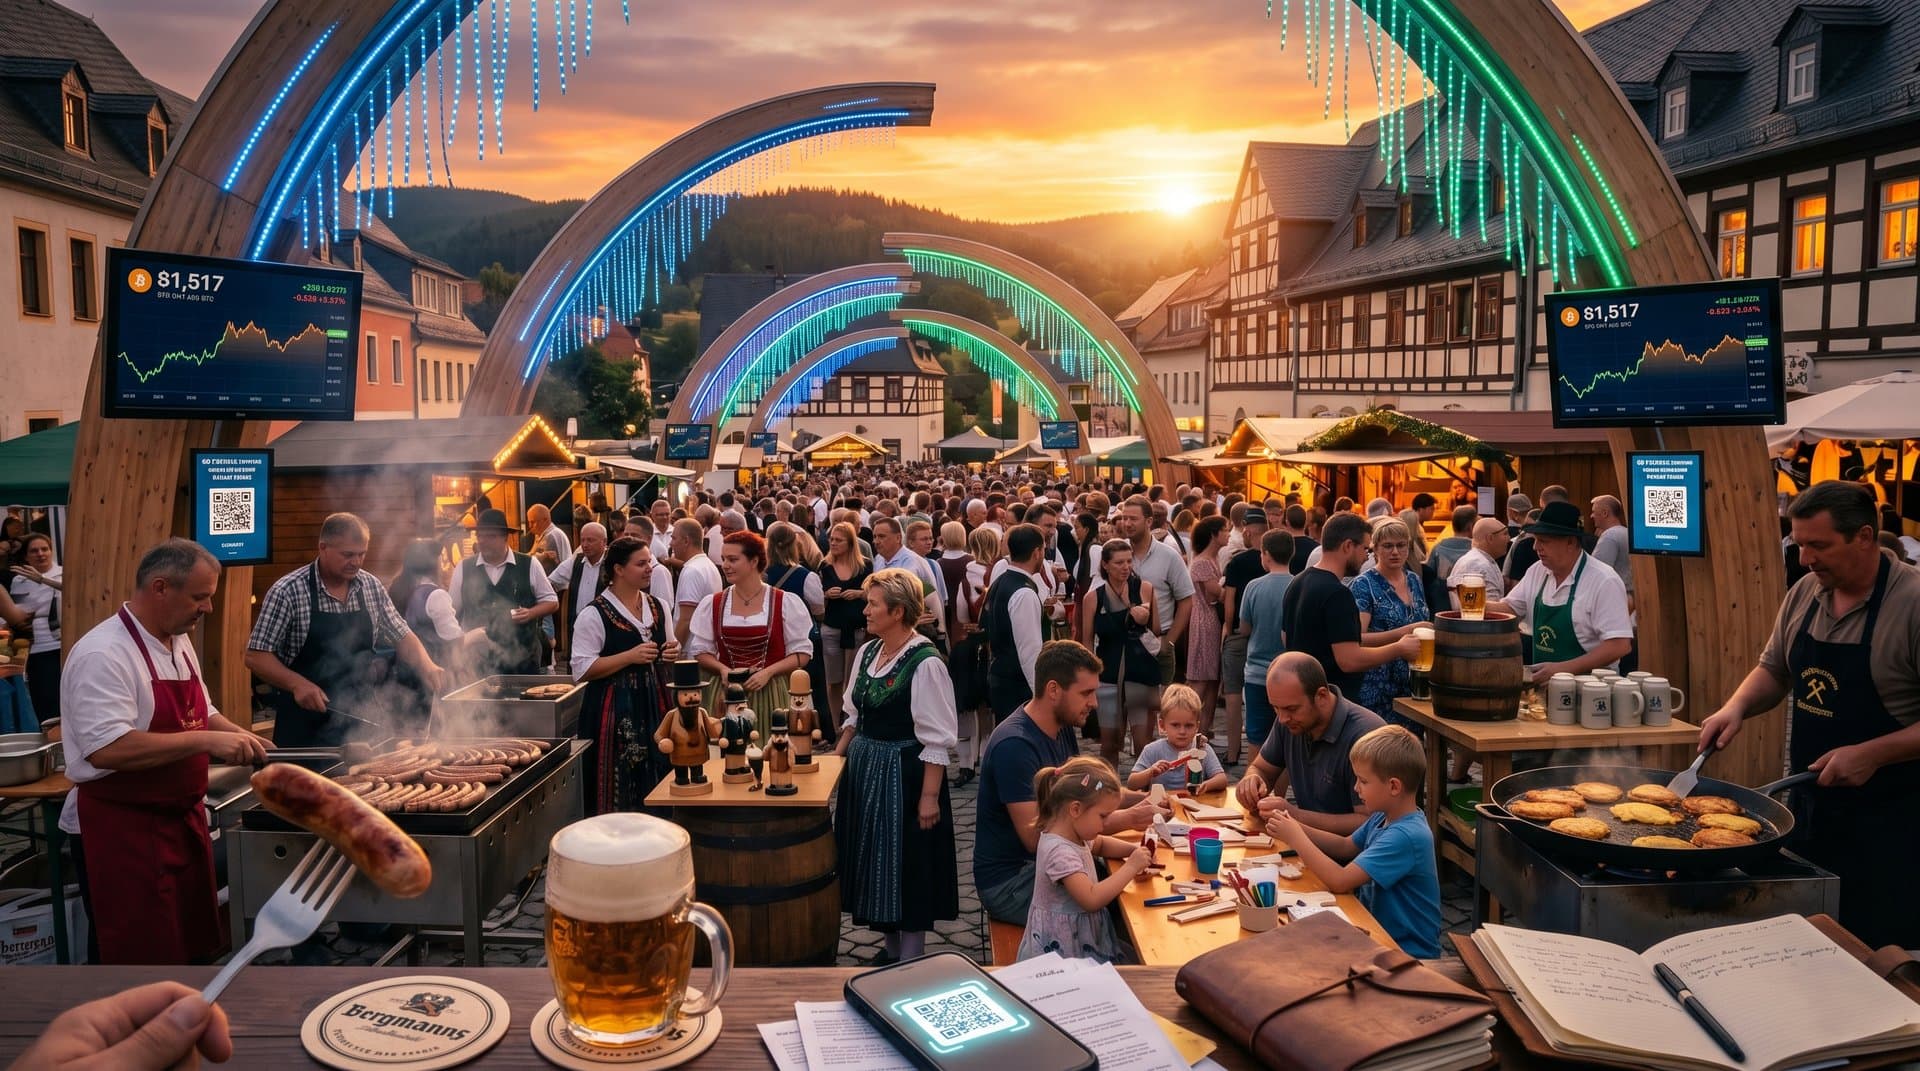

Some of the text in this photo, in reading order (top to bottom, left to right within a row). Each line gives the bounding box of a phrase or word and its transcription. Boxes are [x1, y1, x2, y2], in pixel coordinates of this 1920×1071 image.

[157, 270, 224, 292] $1,517
[1584, 303, 1640, 323] $1,517
[341, 1003, 471, 1040] Bergmanns
